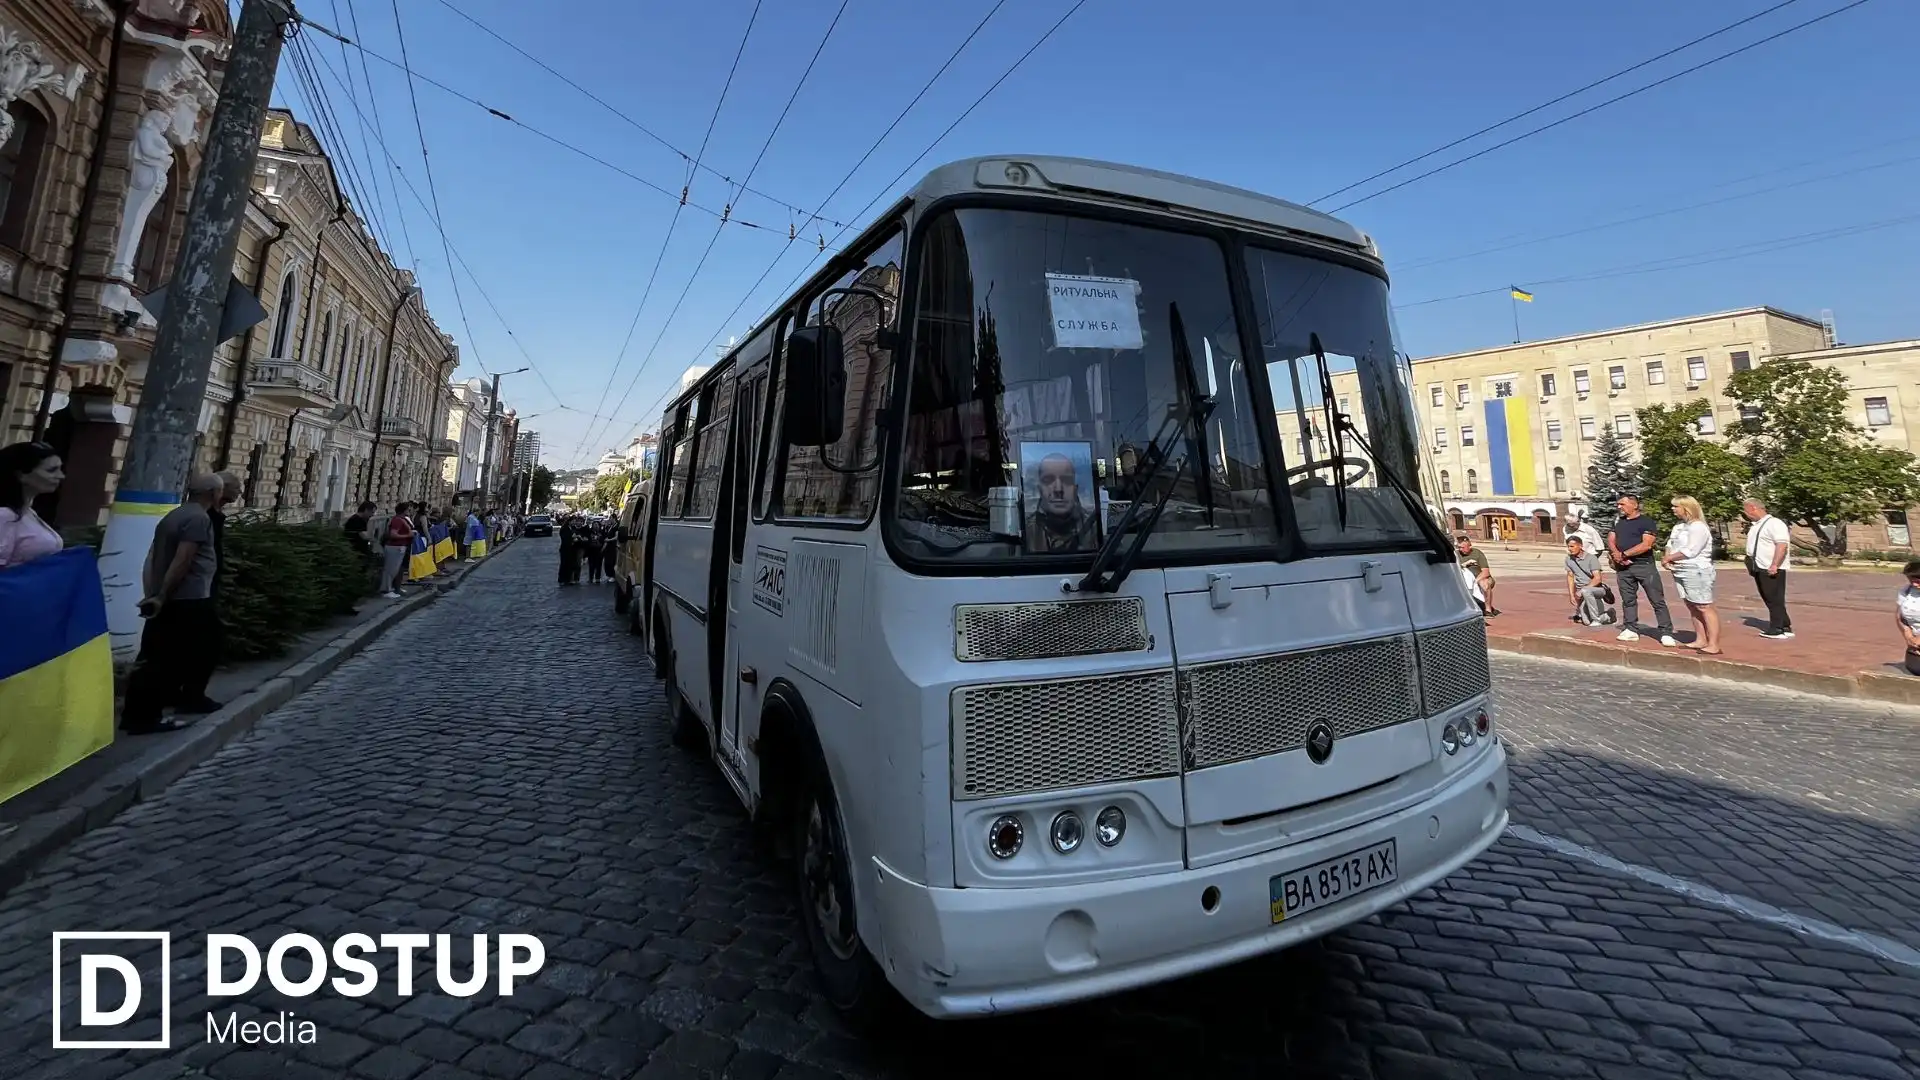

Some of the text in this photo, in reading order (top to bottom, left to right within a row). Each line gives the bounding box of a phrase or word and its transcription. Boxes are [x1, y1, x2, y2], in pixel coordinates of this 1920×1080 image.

[1053, 286, 1119, 299] РИТУАЛЬНА
[1058, 319, 1119, 332] СЛУЖБА
[1284, 847, 1393, 912] BA 8513 AX
